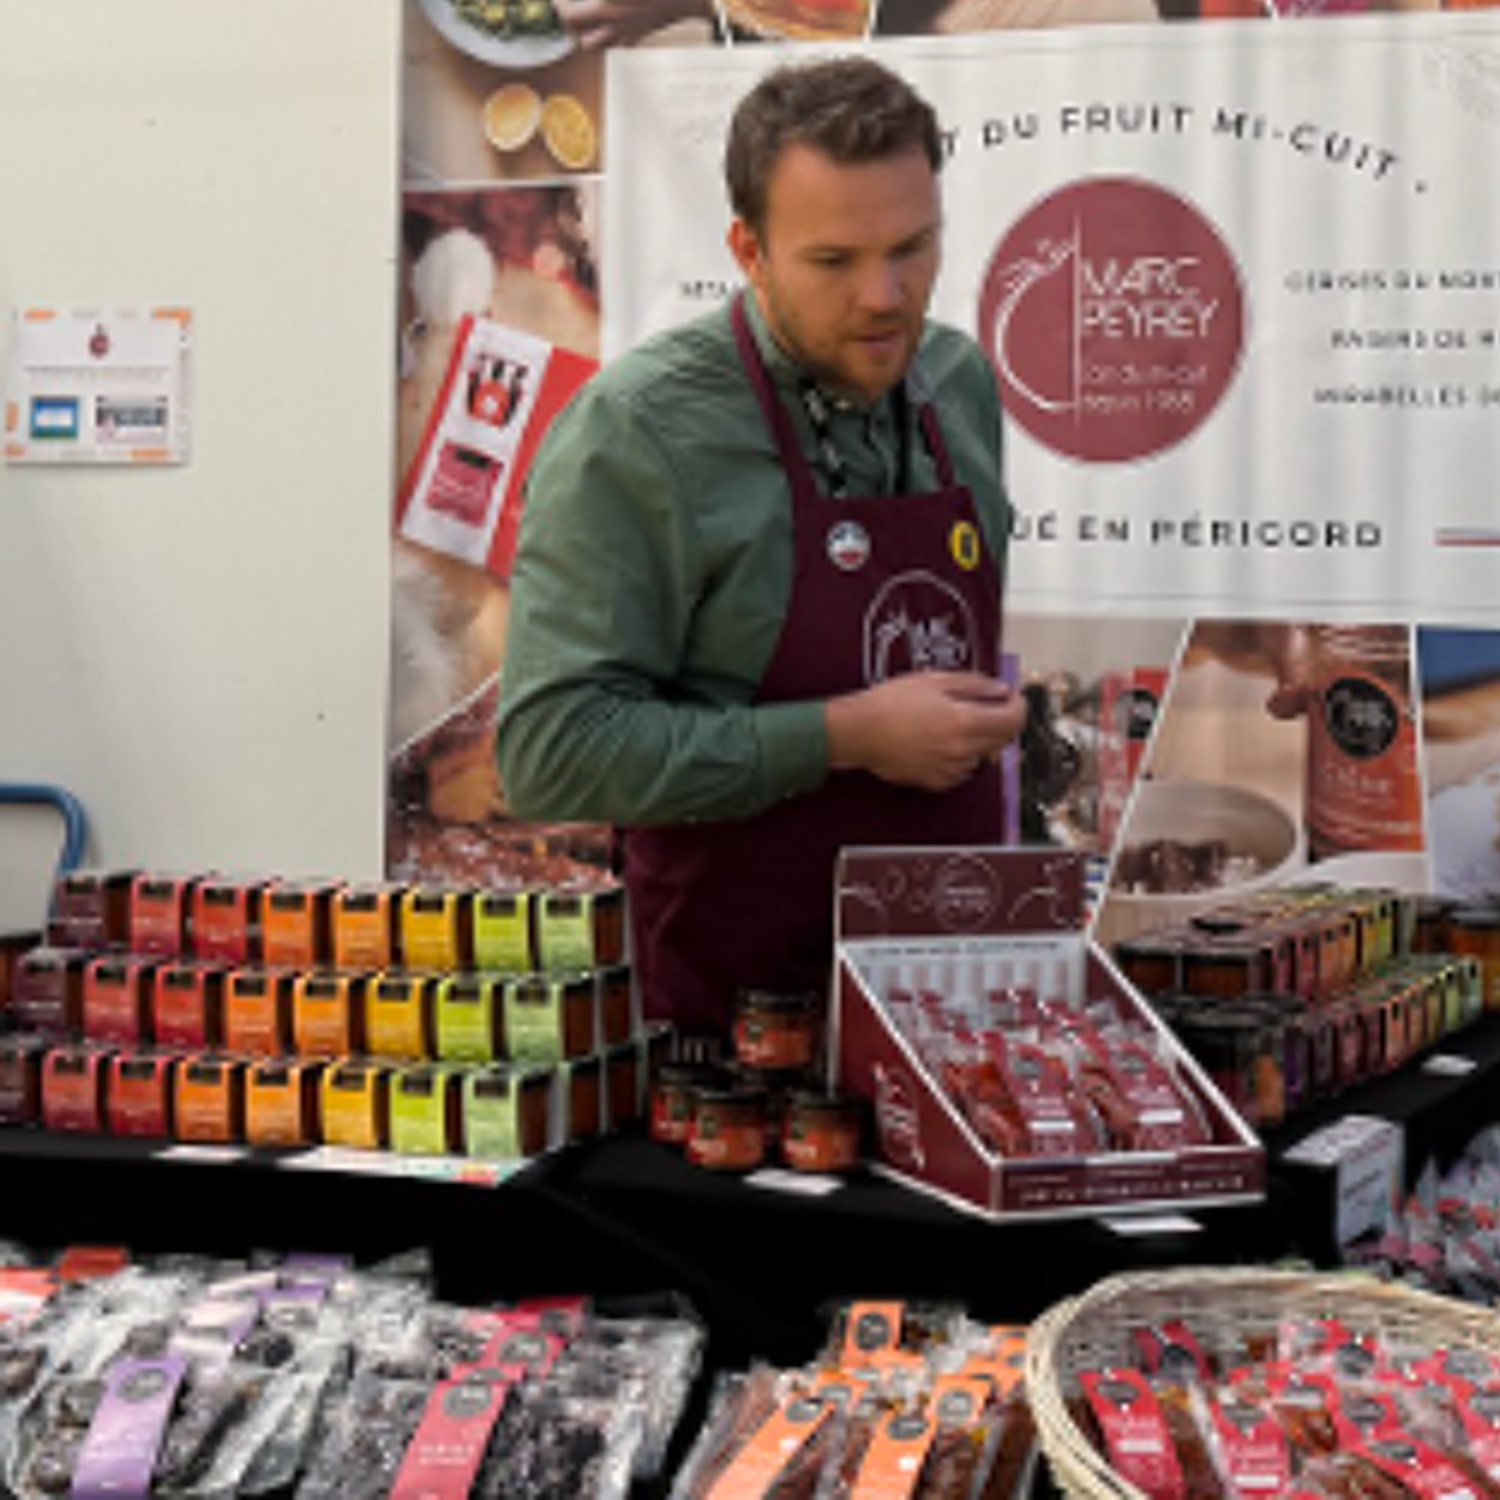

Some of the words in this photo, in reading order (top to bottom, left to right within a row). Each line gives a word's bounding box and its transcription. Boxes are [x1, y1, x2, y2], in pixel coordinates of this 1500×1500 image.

[983, 113, 1038, 148] DU
[1061, 105, 1192, 134] FRUIT
[1213, 107, 1398, 180] MI-CUIT
[1084, 255, 1201, 295] MARC
[1083, 298, 1219, 338] PEYREY
[1079, 516, 1129, 542] EN
[1151, 510, 1382, 548] PÉRIGORD
